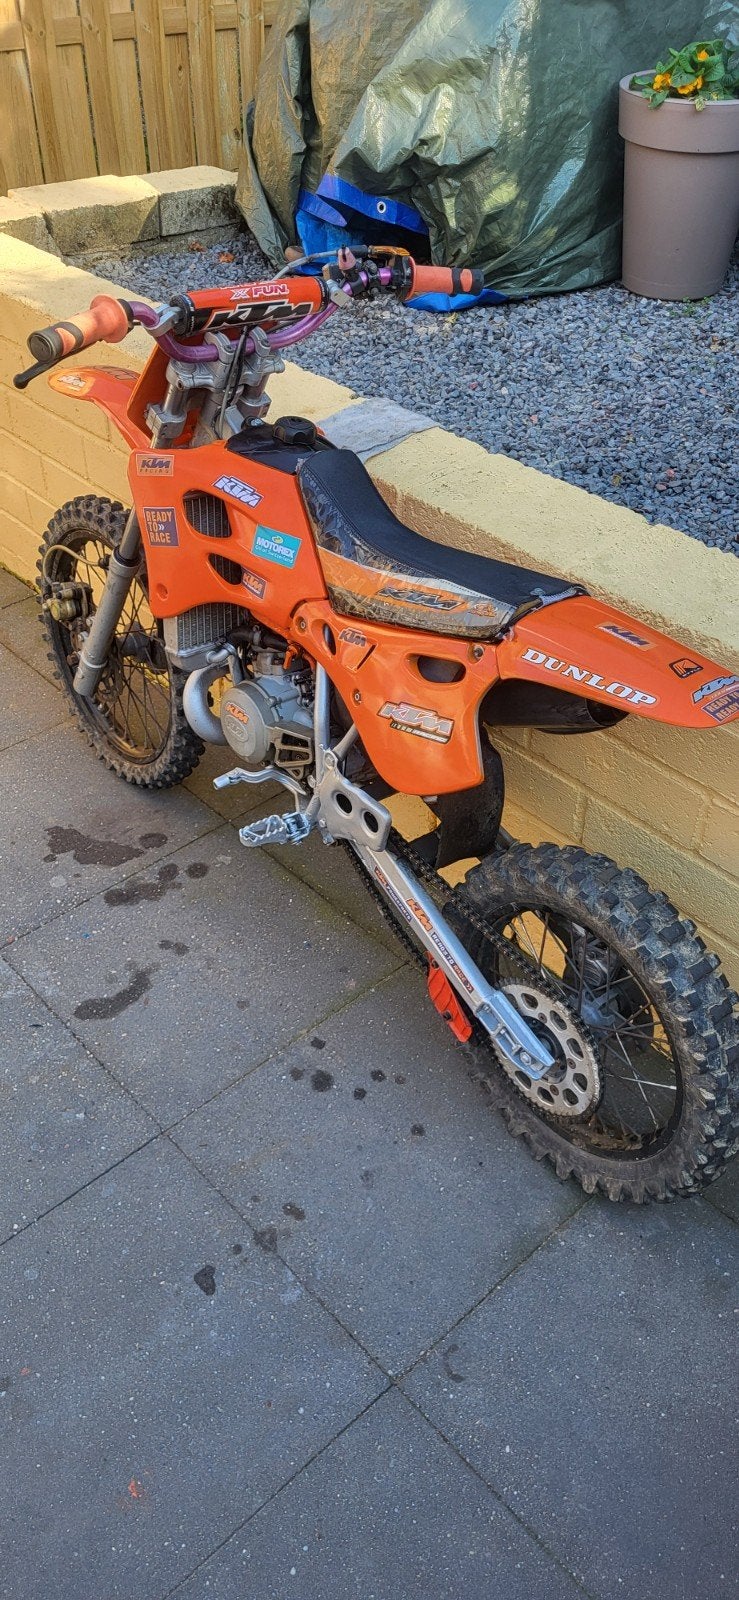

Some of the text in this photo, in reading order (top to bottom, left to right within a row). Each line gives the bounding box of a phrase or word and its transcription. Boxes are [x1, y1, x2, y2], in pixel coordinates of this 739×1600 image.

[205, 299, 313, 331] KTM
[141, 457, 171, 469] KTM
[212, 475, 264, 509] KTM
[145, 511, 172, 522] READY
[148, 521, 159, 532] TO
[150, 532, 171, 543] RACE
[256, 536, 295, 558] MOTOREX
[243, 572, 263, 591] KTM
[378, 587, 466, 611] KTM
[339, 627, 366, 647] KTM
[603, 625, 651, 646] KTM
[521, 648, 657, 705] DUNLOP
[225, 703, 250, 724] KTM
[706, 694, 732, 712] READY
[378, 702, 455, 737] KTM
[406, 898, 433, 932] KTM
